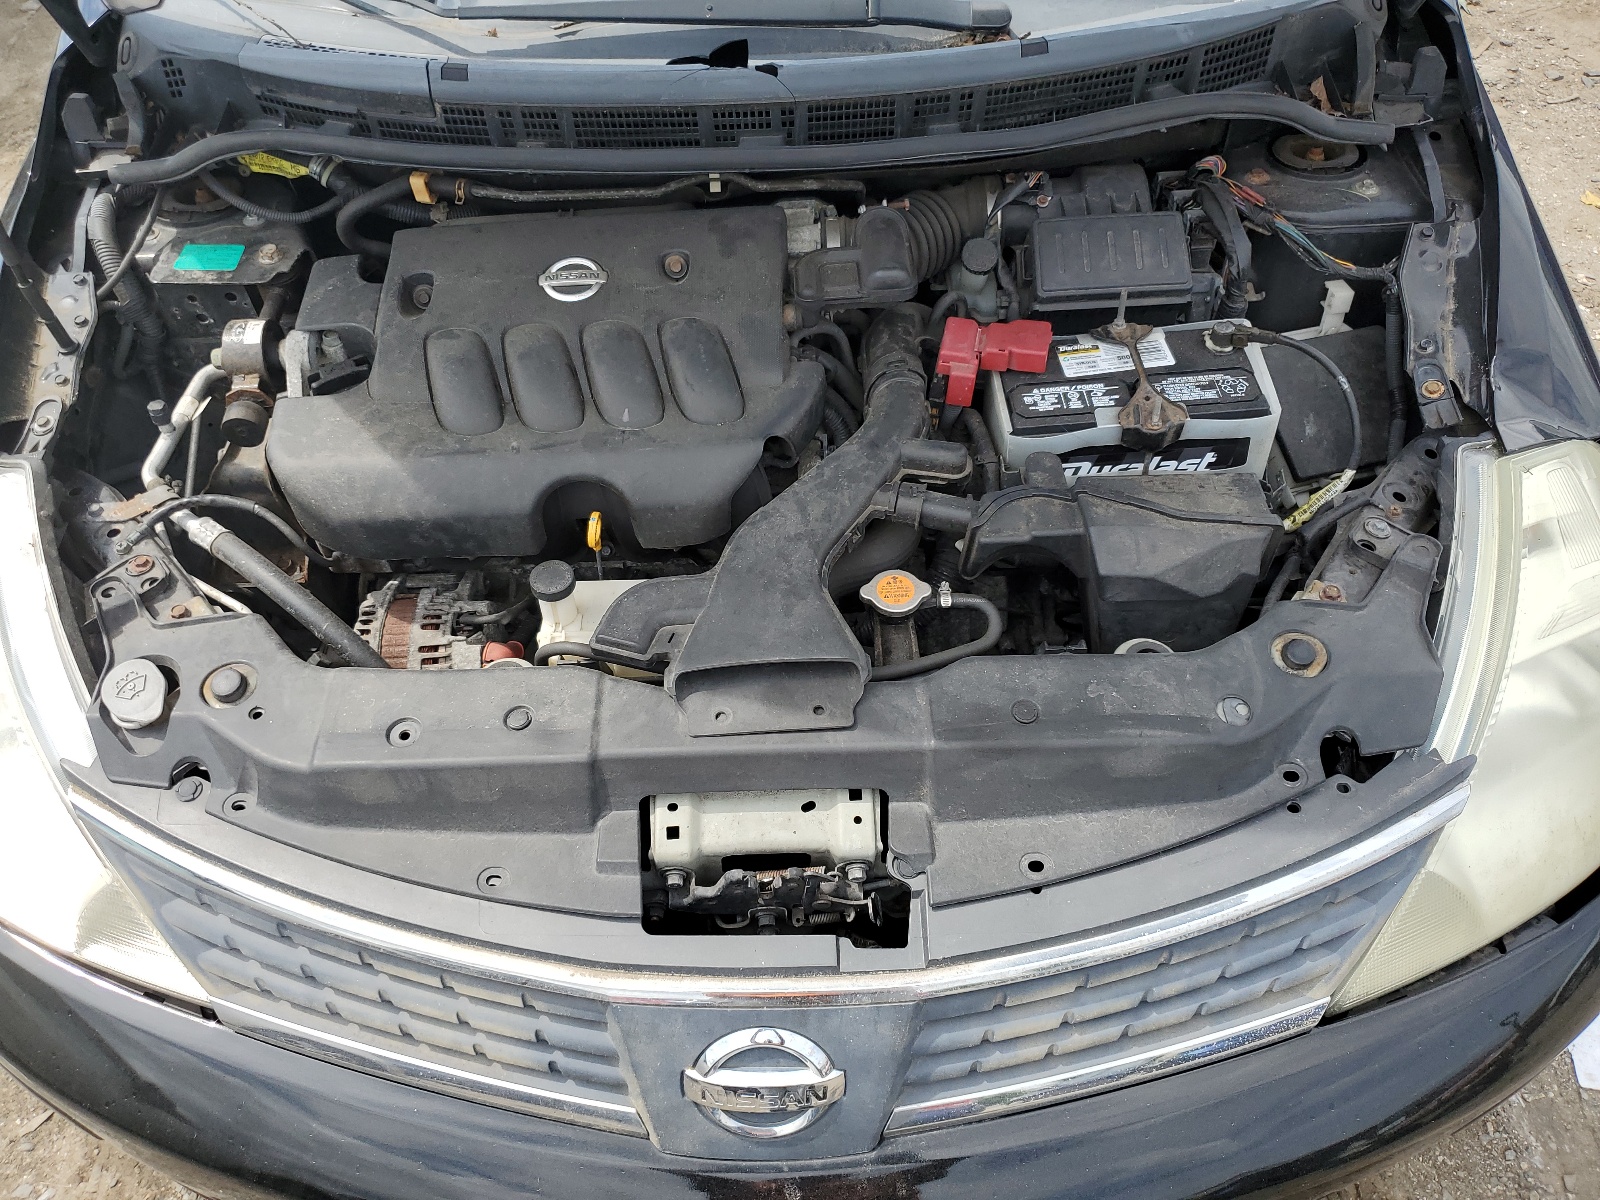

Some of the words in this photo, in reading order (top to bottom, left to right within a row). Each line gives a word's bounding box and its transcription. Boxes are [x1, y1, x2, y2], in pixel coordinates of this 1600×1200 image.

[544, 272, 600, 281] NISSAN
[1062, 452, 1218, 476] Duralast
[701, 1085, 829, 1108] NISSAN
